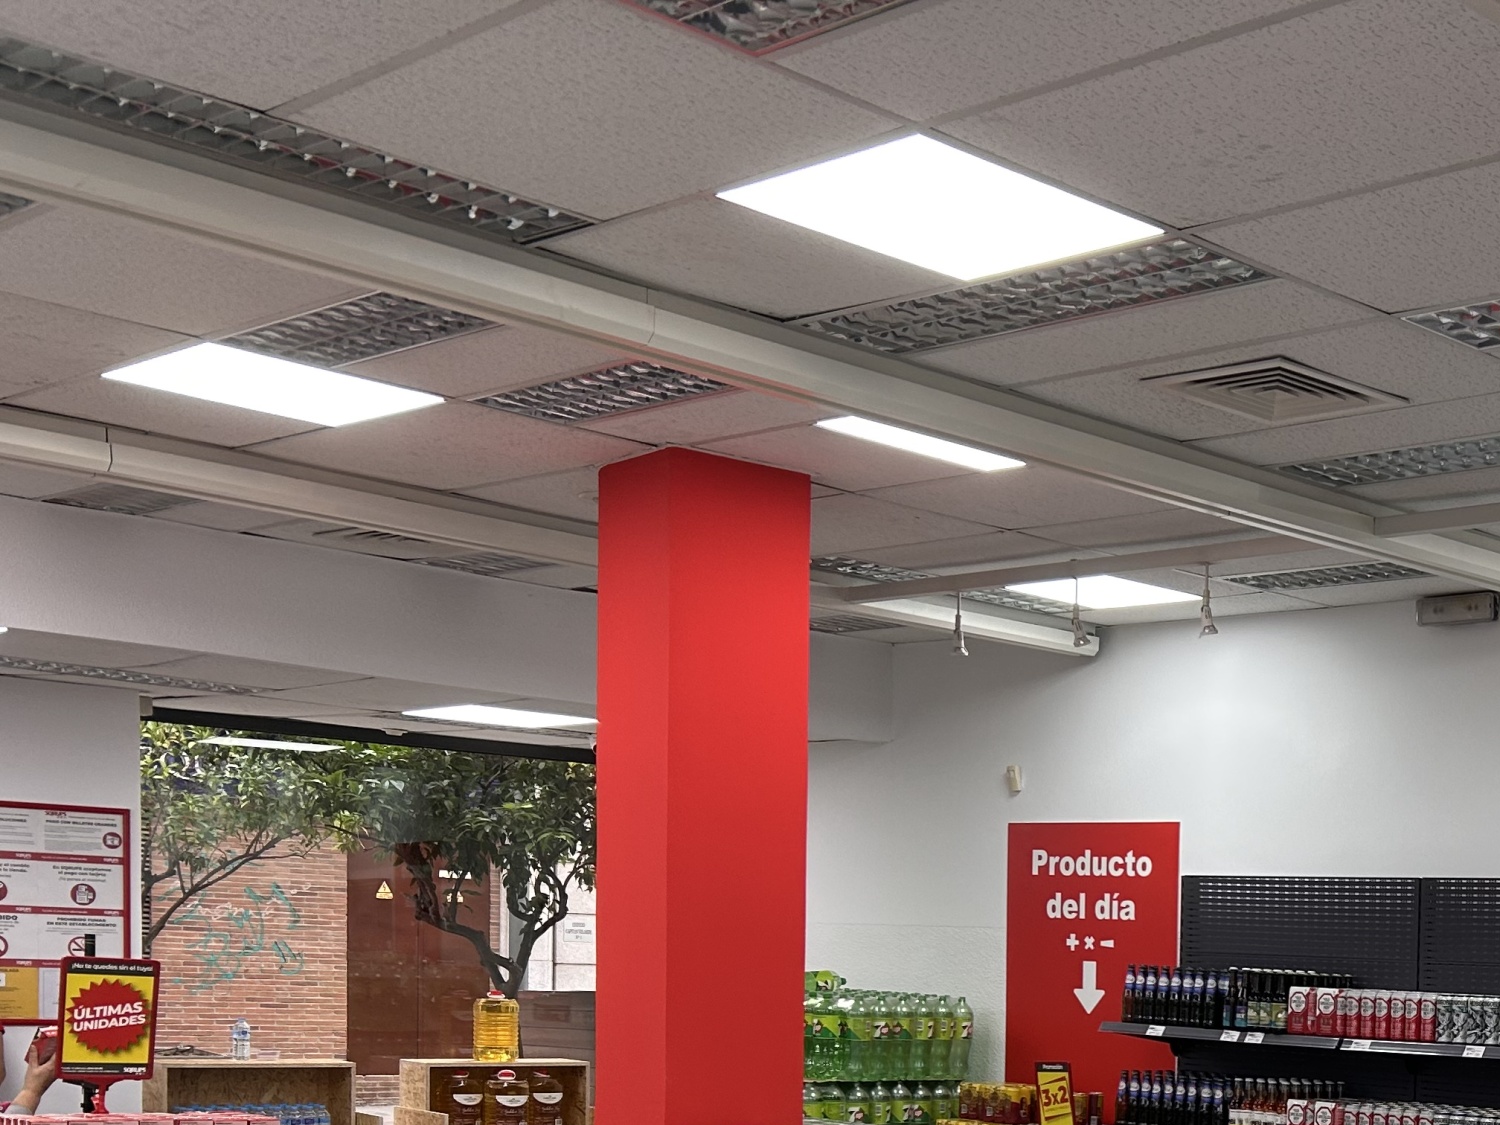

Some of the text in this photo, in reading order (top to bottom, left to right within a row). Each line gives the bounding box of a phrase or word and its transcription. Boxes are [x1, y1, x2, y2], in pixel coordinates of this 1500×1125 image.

[1031, 849, 1152, 877] Producto
[1046, 892, 1136, 921] del día
[74, 1001, 143, 1020] ÚLTIMAS
[74, 1015, 146, 1032] UNIDADES
[1042, 1086, 1069, 1107] 3x2
